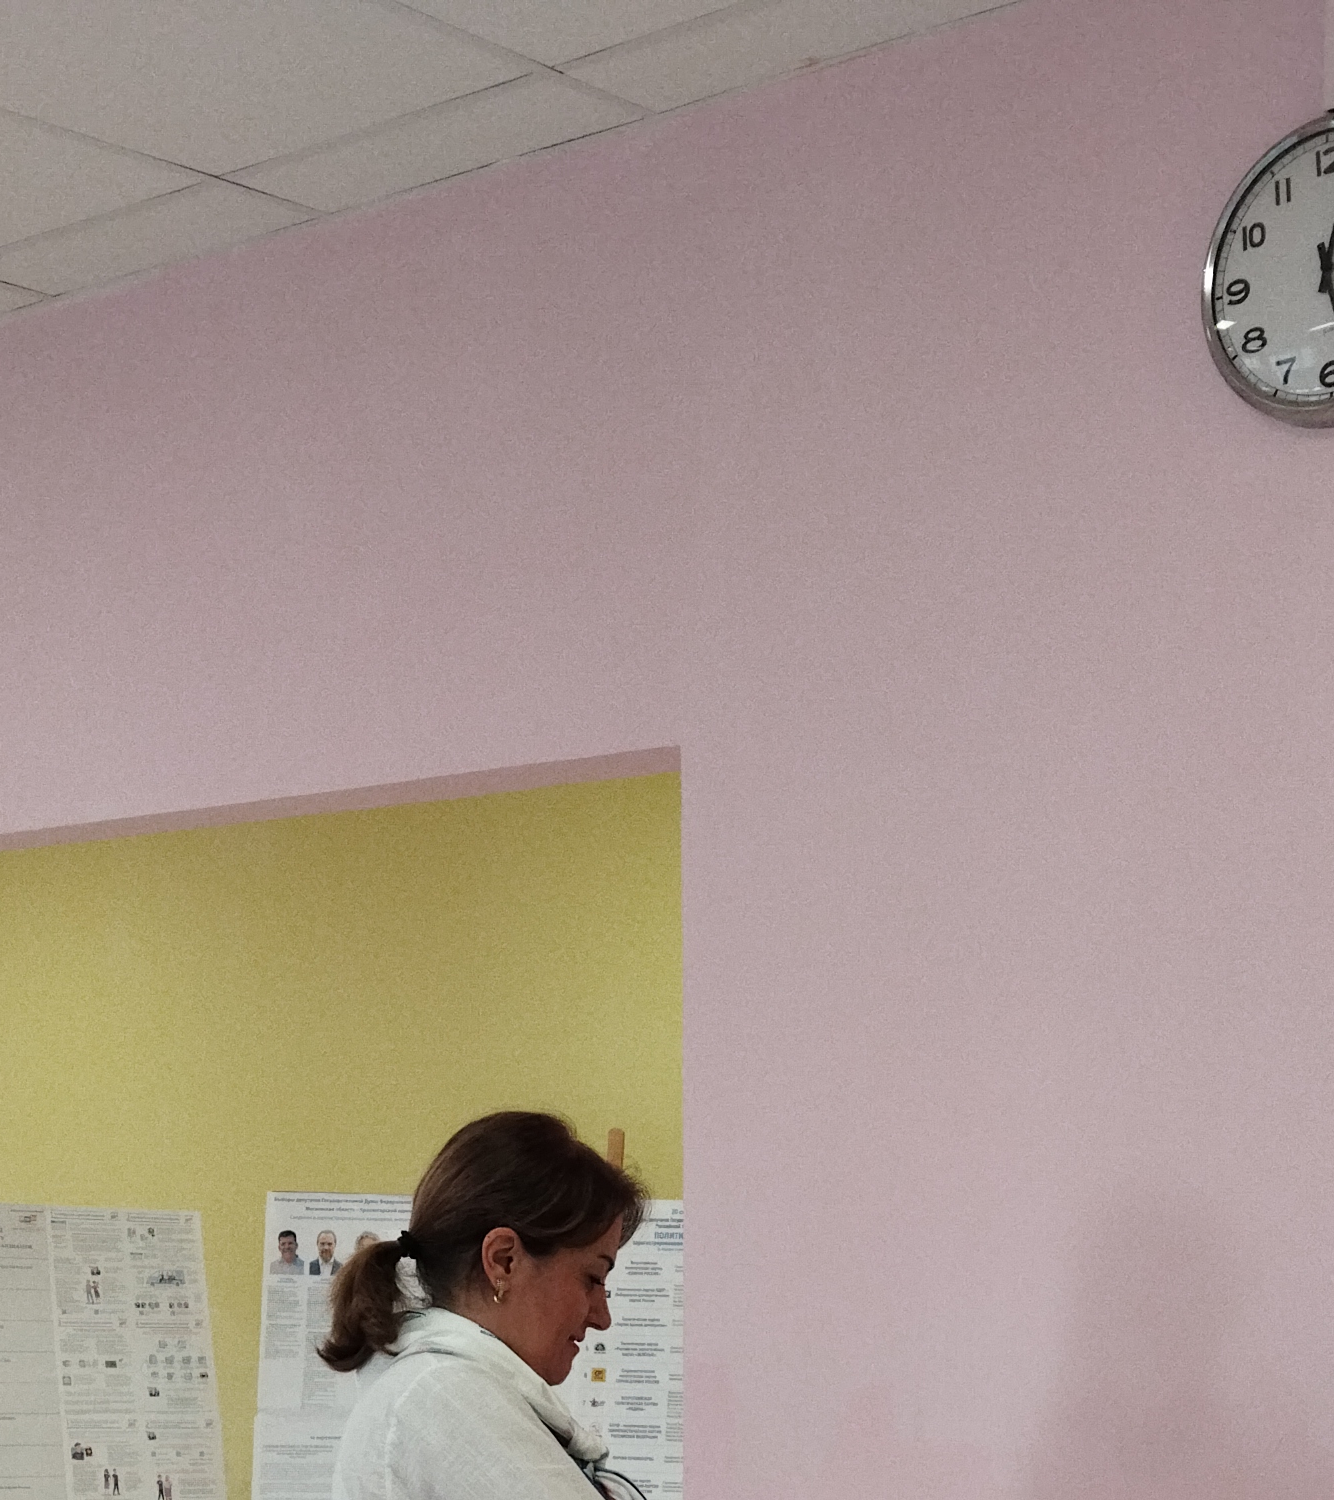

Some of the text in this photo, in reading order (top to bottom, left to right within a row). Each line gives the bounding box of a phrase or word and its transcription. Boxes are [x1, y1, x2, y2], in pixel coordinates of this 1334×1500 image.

[1274, 177, 1291, 206] 11
[1242, 222, 1266, 251] 10
[1226, 279, 1251, 305] 9
[1241, 327, 1267, 354] 8
[1275, 356, 1296, 385] 7
